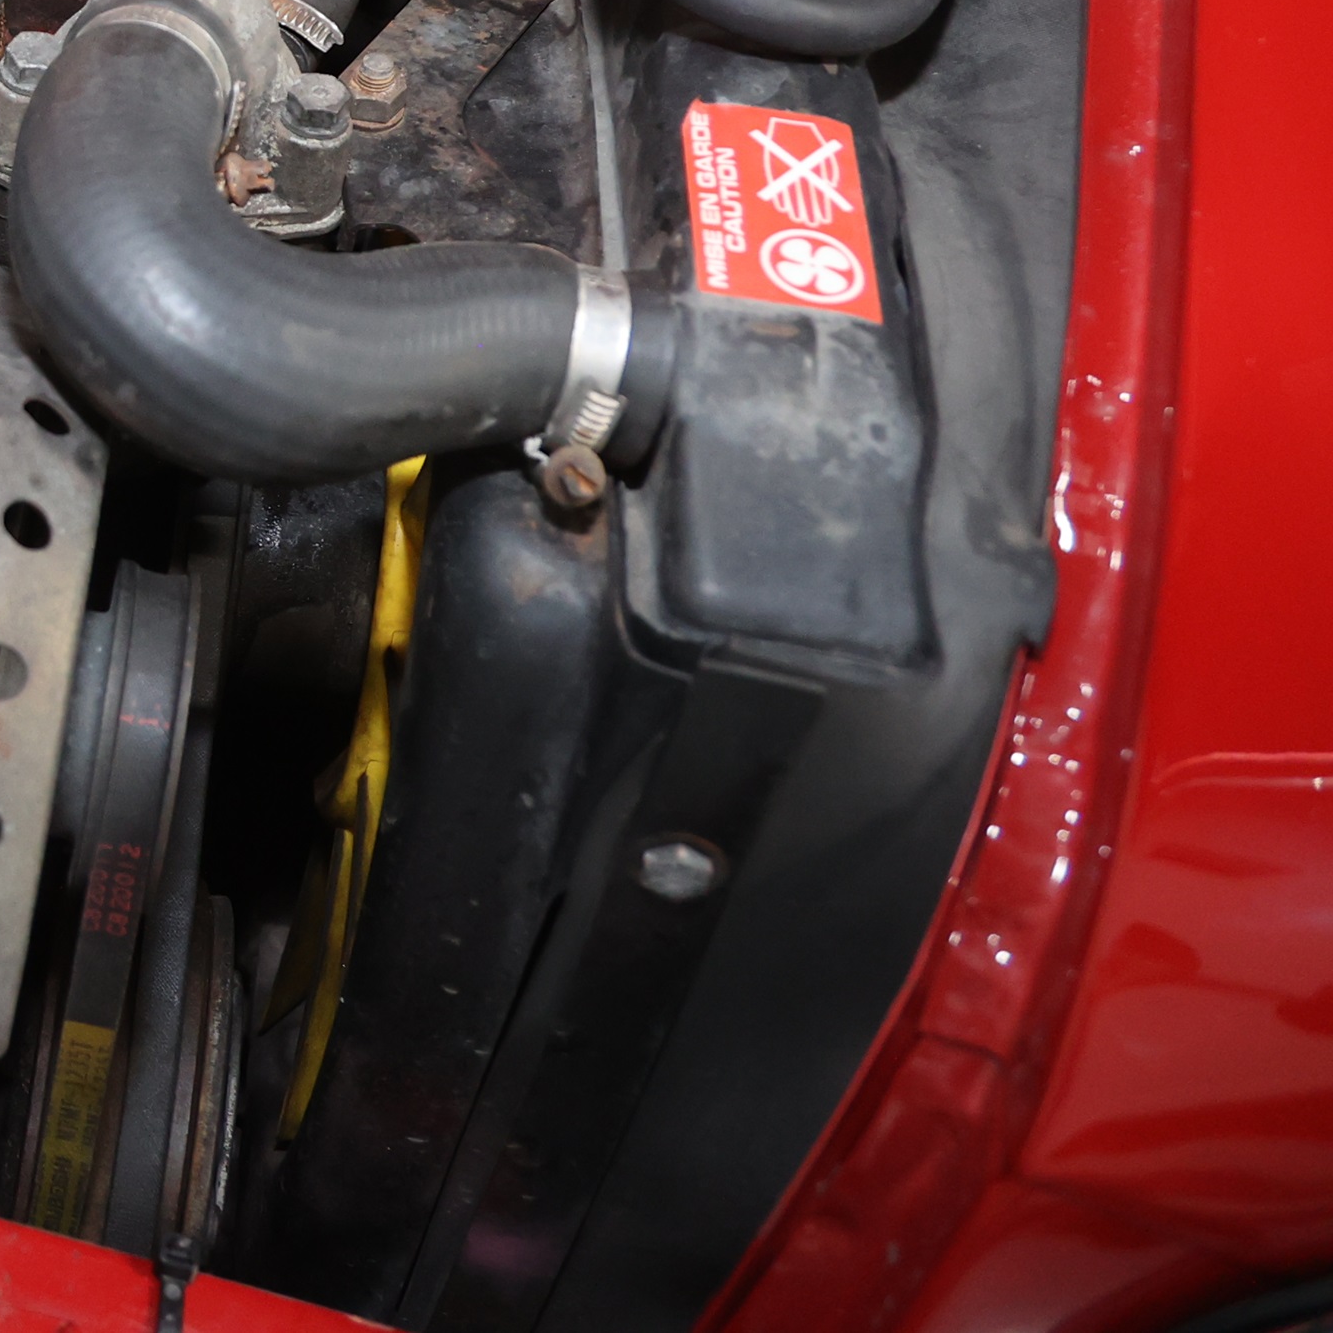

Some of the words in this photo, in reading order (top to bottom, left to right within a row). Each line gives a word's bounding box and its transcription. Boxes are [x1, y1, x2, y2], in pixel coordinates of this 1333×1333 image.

[690, 110, 717, 188] GARDE
[697, 192, 722, 225] EN
[714, 147, 747, 254] CAUTION
[702, 228, 730, 289] MISE
